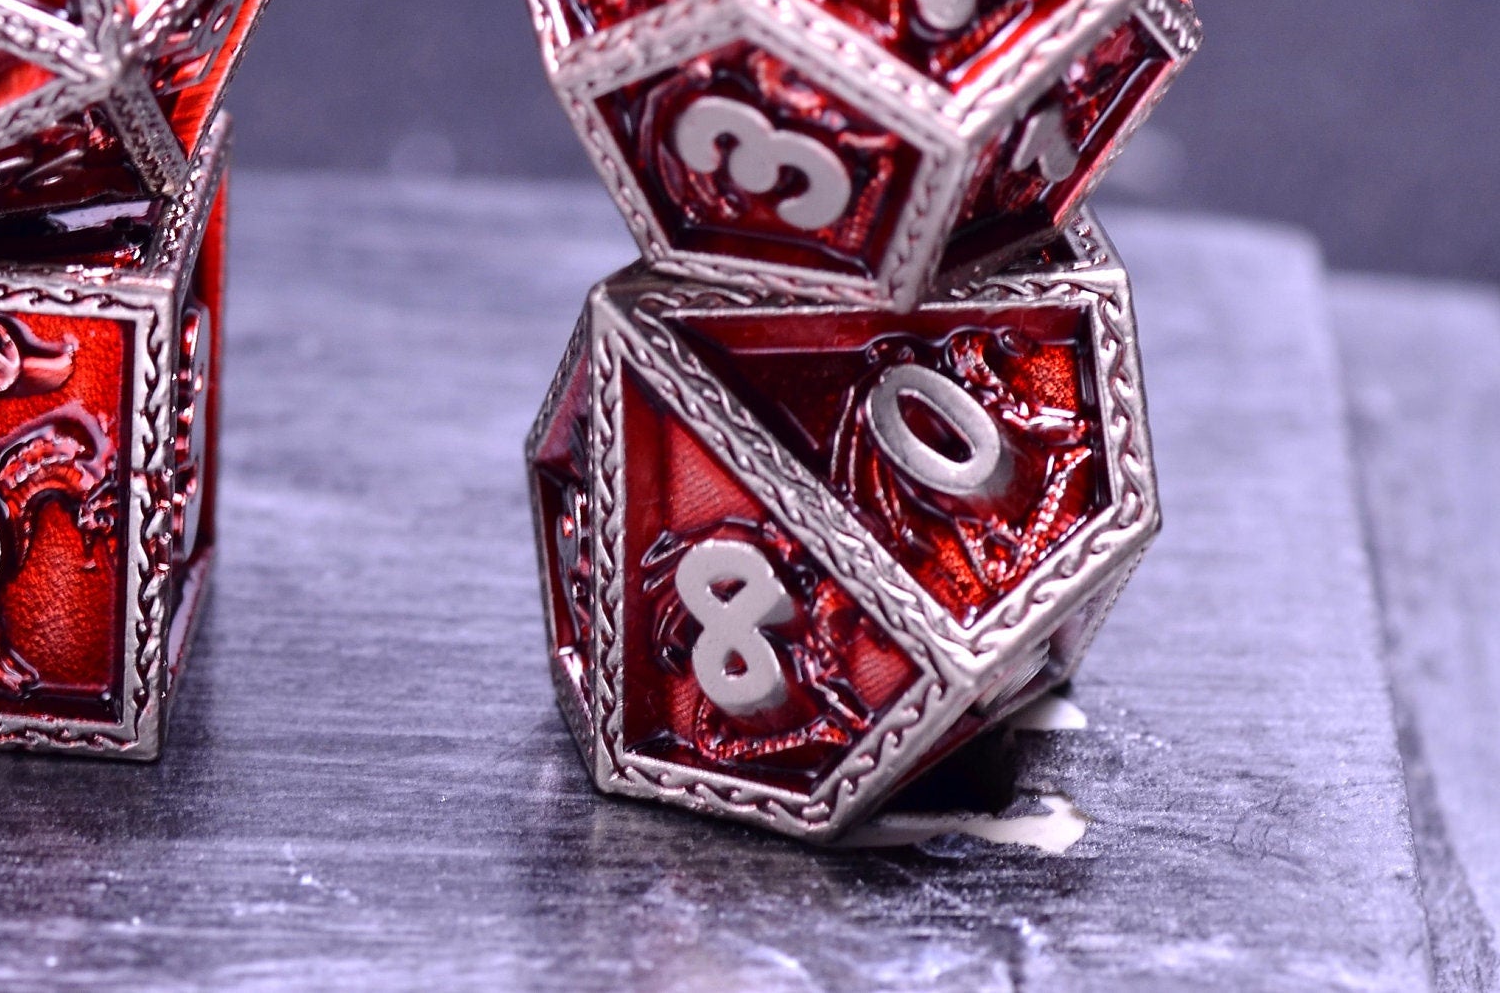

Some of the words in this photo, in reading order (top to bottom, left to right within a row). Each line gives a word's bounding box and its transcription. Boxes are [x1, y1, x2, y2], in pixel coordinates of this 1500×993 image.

[676, 95, 852, 231] 3
[865, 363, 1002, 497] 0
[674, 537, 790, 715] 8
